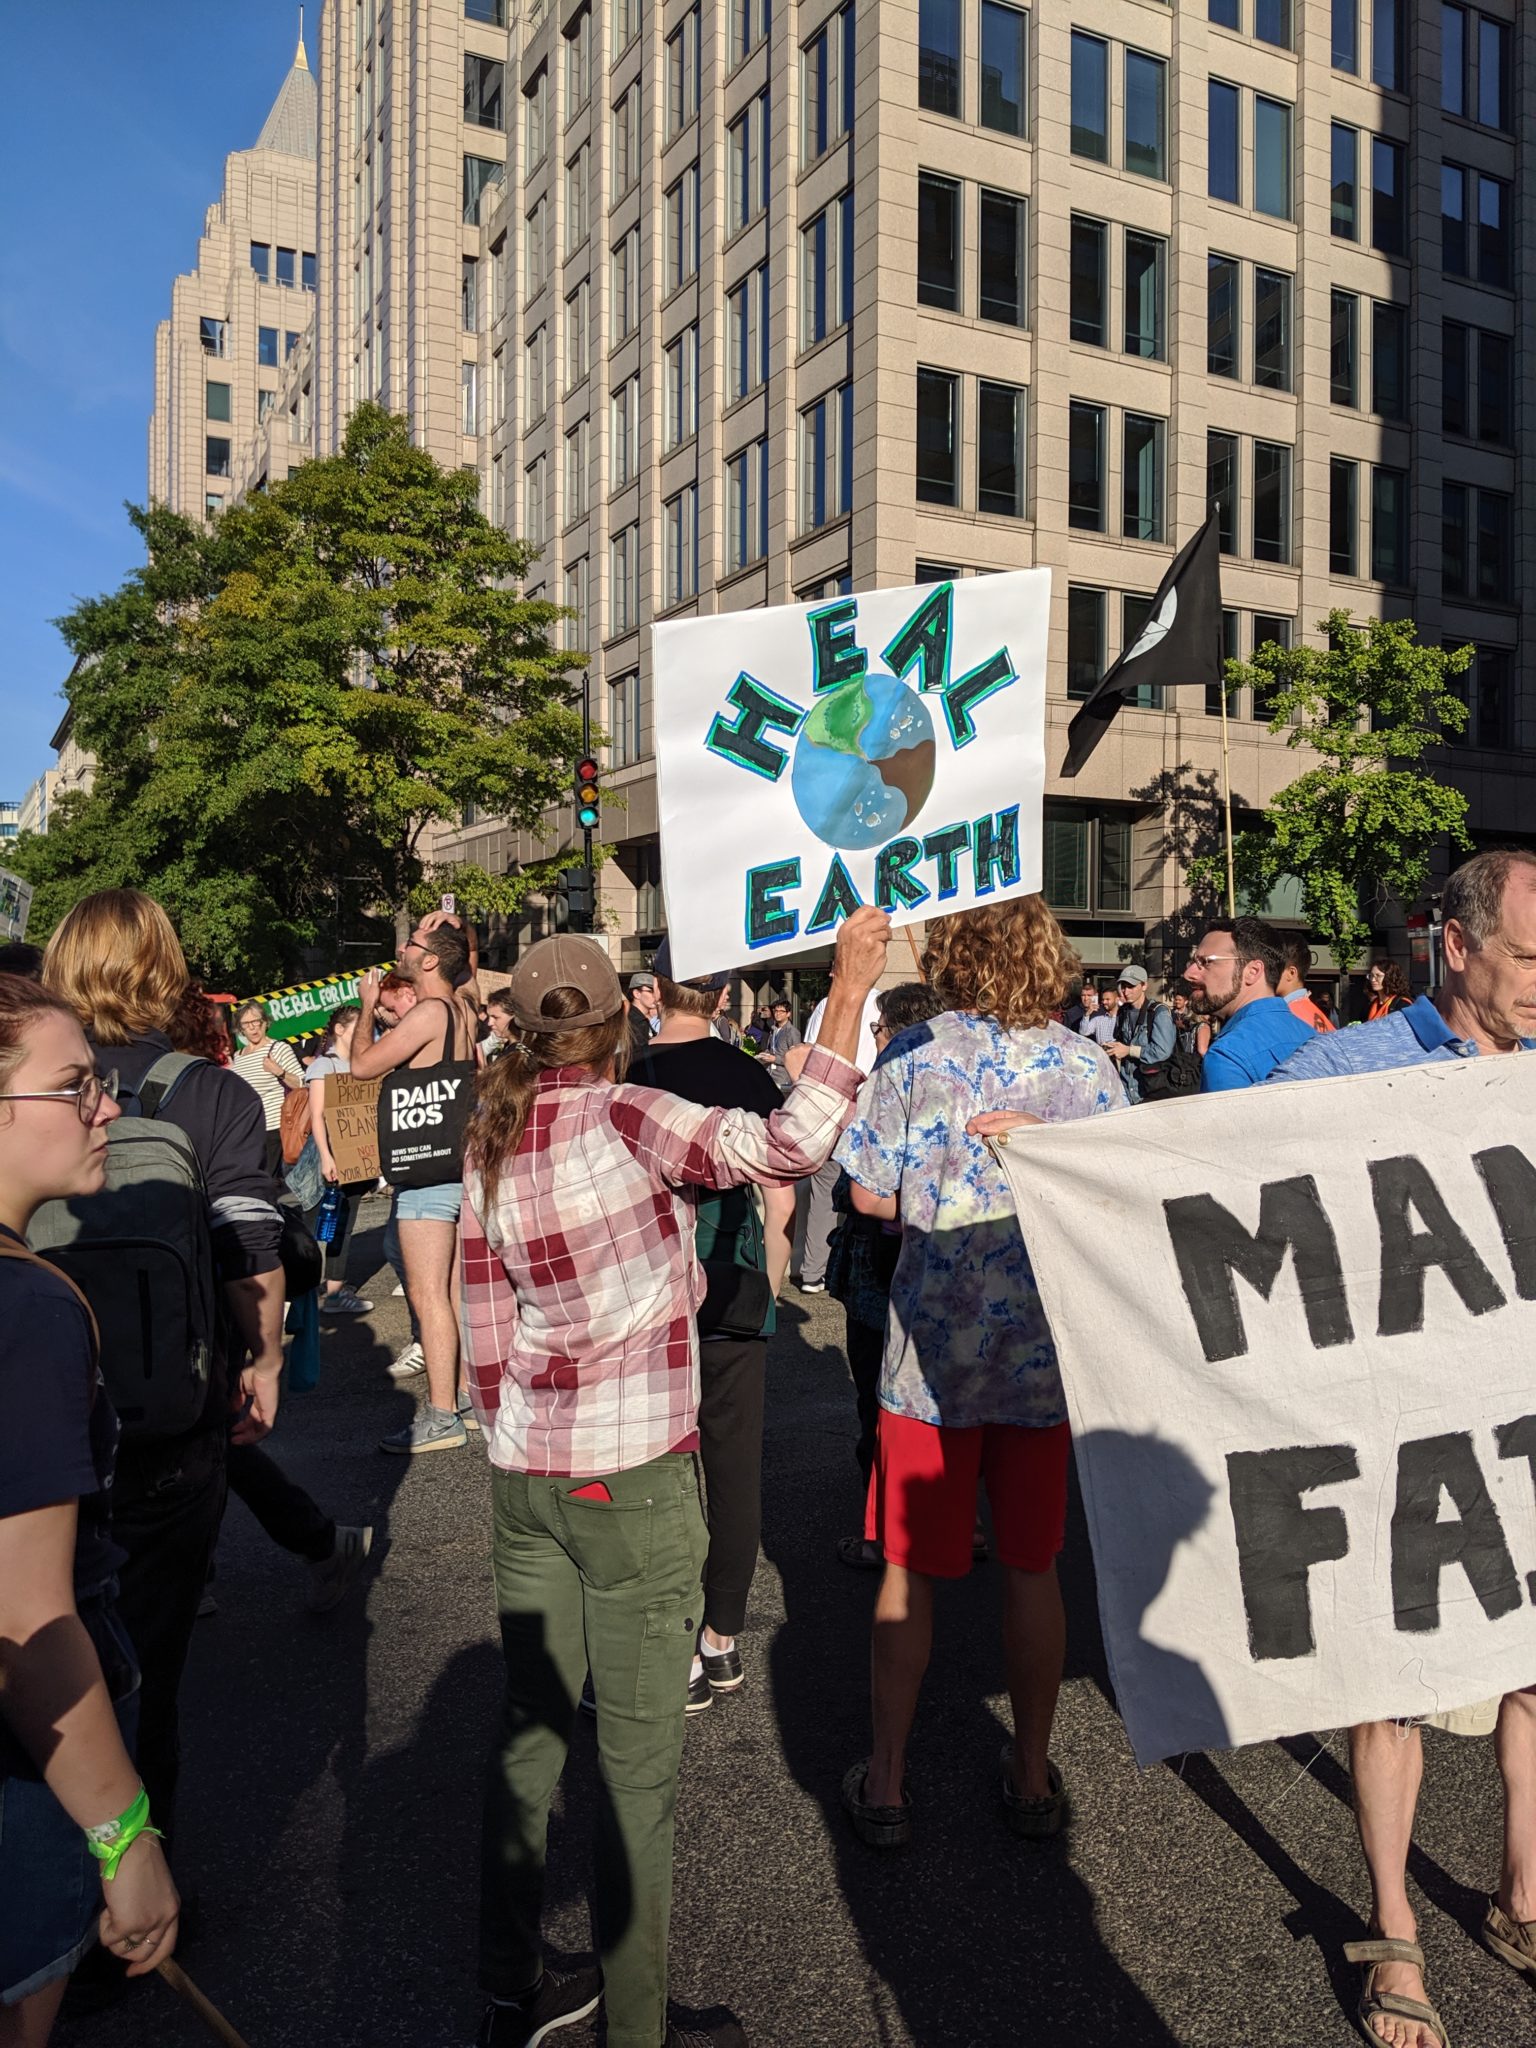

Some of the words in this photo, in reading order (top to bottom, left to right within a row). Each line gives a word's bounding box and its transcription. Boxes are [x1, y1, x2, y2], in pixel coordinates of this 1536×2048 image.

[705, 581, 1019, 783] HEAL
[745, 804, 1020, 949] EARTH
[270, 992, 321, 1021] REBEL
[320, 985, 340, 1006] FOR
[339, 976, 362, 1002] LIF
[391, 1078, 462, 1110] DAILY
[336, 1107, 356, 1118] INTO
[364, 1104, 378, 1114] TH
[391, 1103, 444, 1132] KOS
[357, 1144, 376, 1157] NOT
[391, 1147, 407, 1156] NEWS
[407, 1146, 419, 1154] YOU
[419, 1144, 432, 1152] CAN
[391, 1156, 400, 1164] DO
[400, 1151, 433, 1163] SOMETHING
[433, 1148, 452, 1157] ABOUT
[340, 1166, 362, 1182] YOUR
